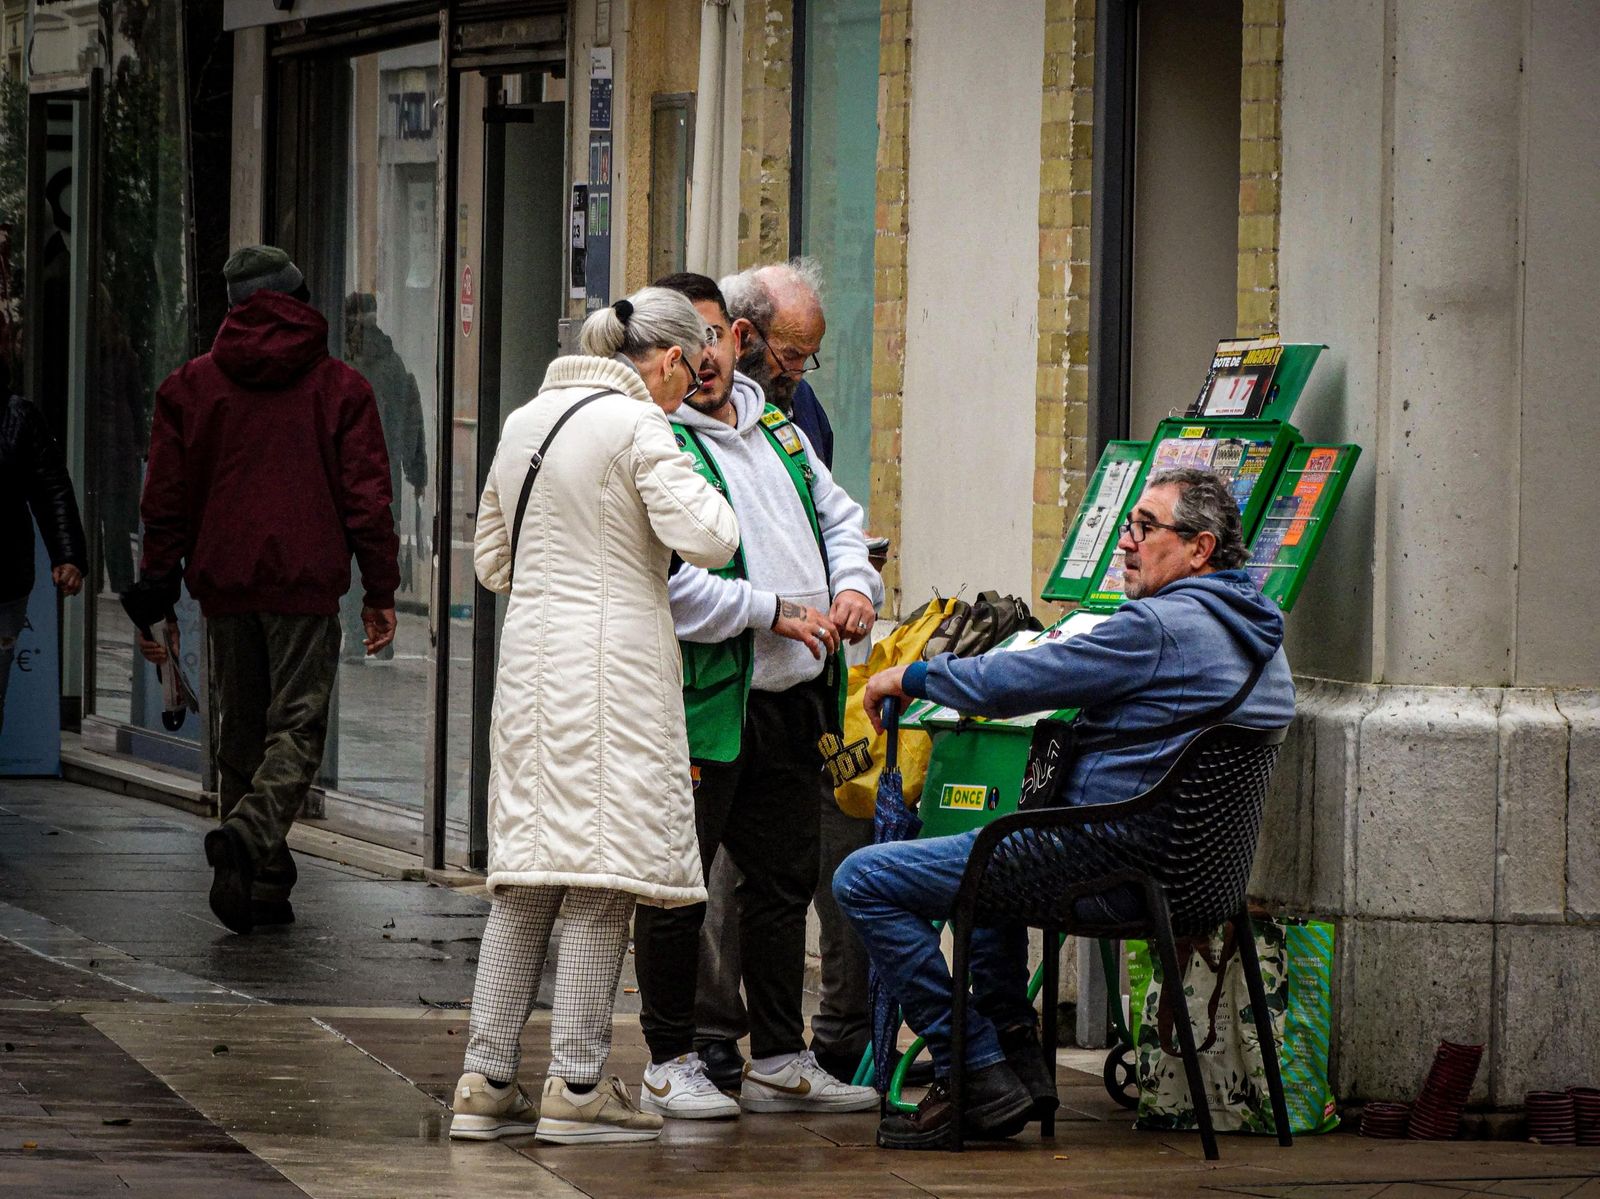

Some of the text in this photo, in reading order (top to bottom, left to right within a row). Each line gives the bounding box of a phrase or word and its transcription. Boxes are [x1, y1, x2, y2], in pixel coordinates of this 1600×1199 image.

[1213, 357, 1230, 368] BOTE
[1230, 357, 1242, 367] DE
[1243, 347, 1281, 366] JACKPOT
[954, 789, 983, 805] ONCE
